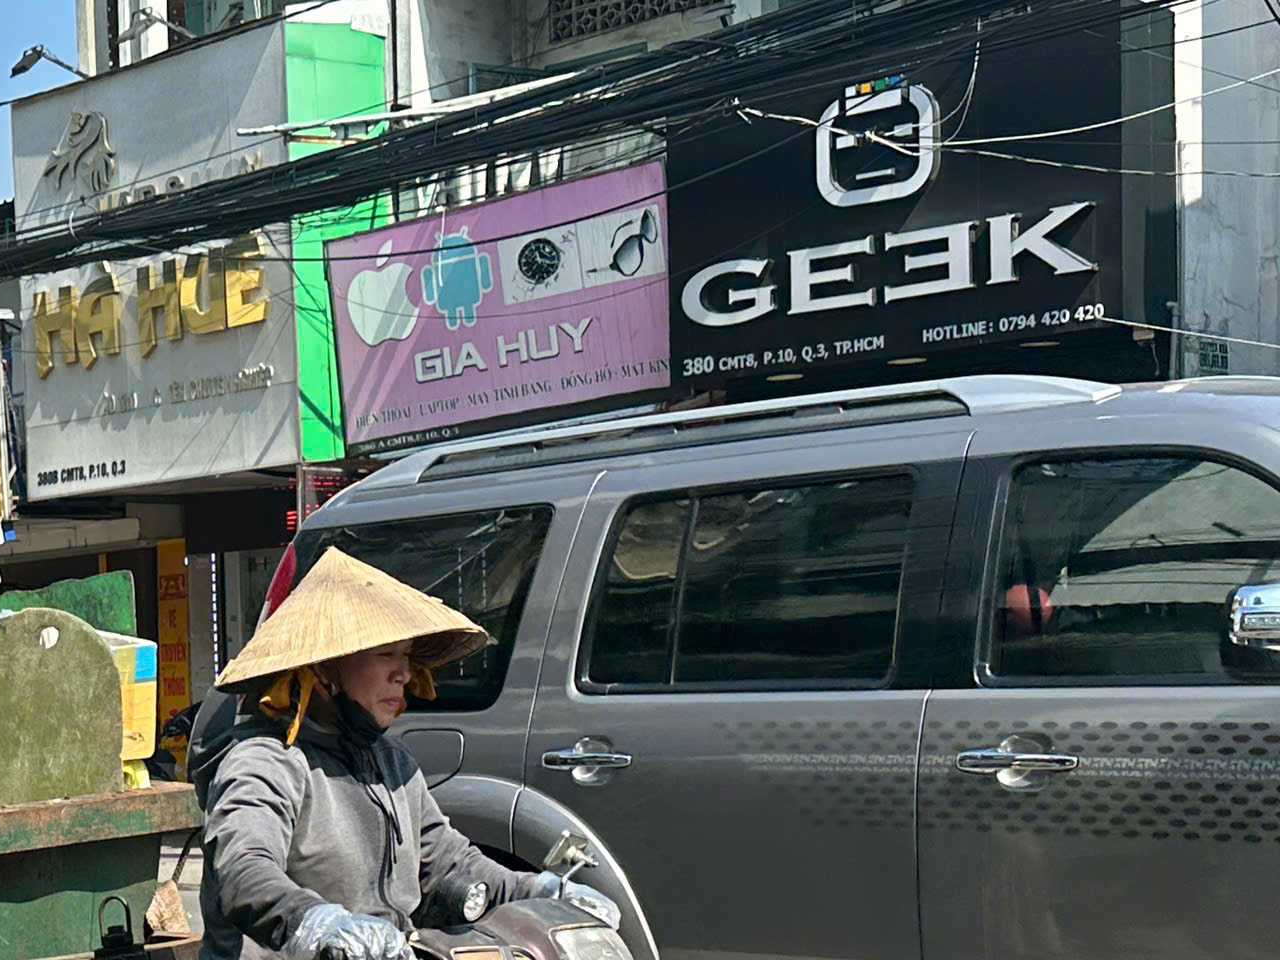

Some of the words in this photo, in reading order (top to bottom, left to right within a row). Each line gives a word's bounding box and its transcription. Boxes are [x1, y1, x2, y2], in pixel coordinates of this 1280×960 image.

[681, 201, 1099, 327] GEEK
[922, 320, 994, 344] HOTLINE:
[999, 312, 1035, 333] 0794
[1041, 308, 1069, 326] 420
[1074, 303, 1106, 323] 420
[413, 341, 488, 384] GIA
[496, 316, 593, 367] HUY
[683, 355, 714, 376] 380
[719, 354, 759, 373] CMT8,
[763, 349, 797, 366] P.10,
[802, 343, 829, 363] Q.3,
[834, 334, 885, 355] TP.HCM
[61, 466, 86, 484] CMT8,
[88, 462, 109, 480] P.10,
[112, 460, 127, 476] Q.3
